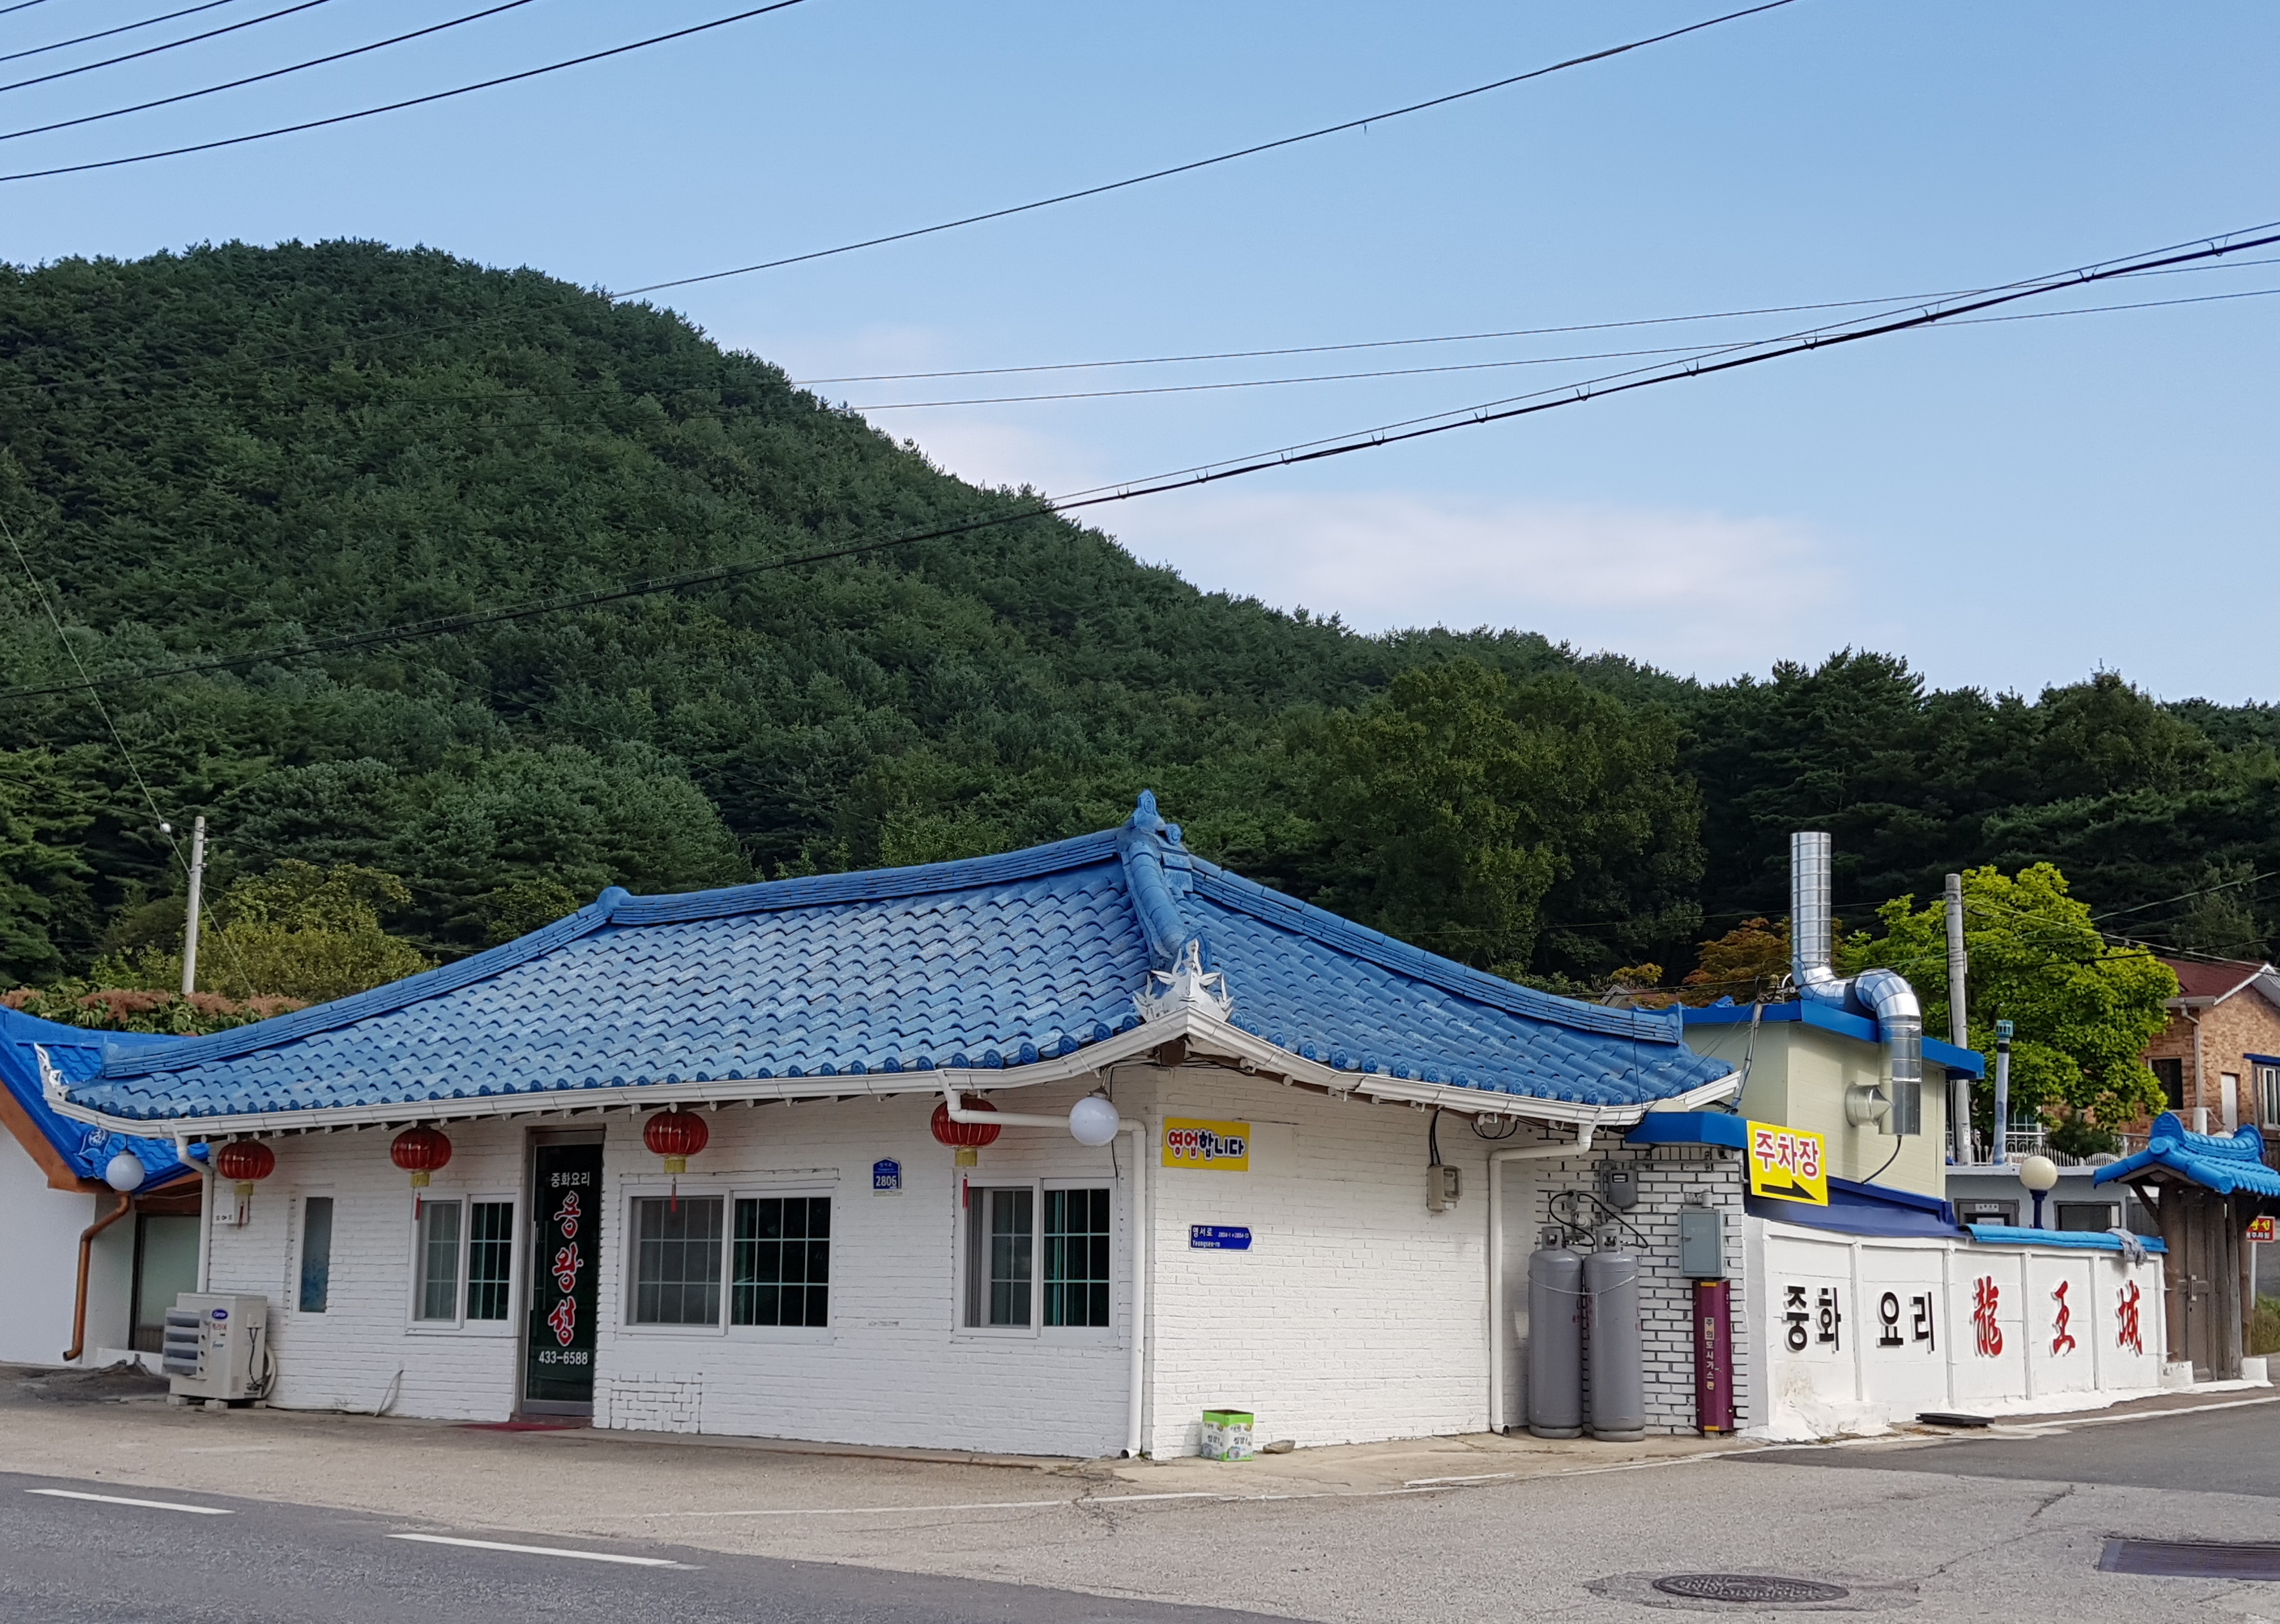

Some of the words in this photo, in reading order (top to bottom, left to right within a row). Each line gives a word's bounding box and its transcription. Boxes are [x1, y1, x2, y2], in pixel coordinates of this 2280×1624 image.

[1168, 1131, 1244, 1159] 영업합니다
[1754, 1131, 1819, 1178] 주차장
[550, 1172, 590, 1187] 중화요리
[876, 1176, 897, 1187] 2806
[1192, 1227, 1213, 1238] 영서로
[548, 1191, 584, 1347] 용왕성
[1705, 1319, 1714, 1339] 주의
[1785, 1286, 1841, 1352] 중화
[1878, 1291, 1935, 1352] 요리
[538, 1351, 588, 1366] 433-6588
